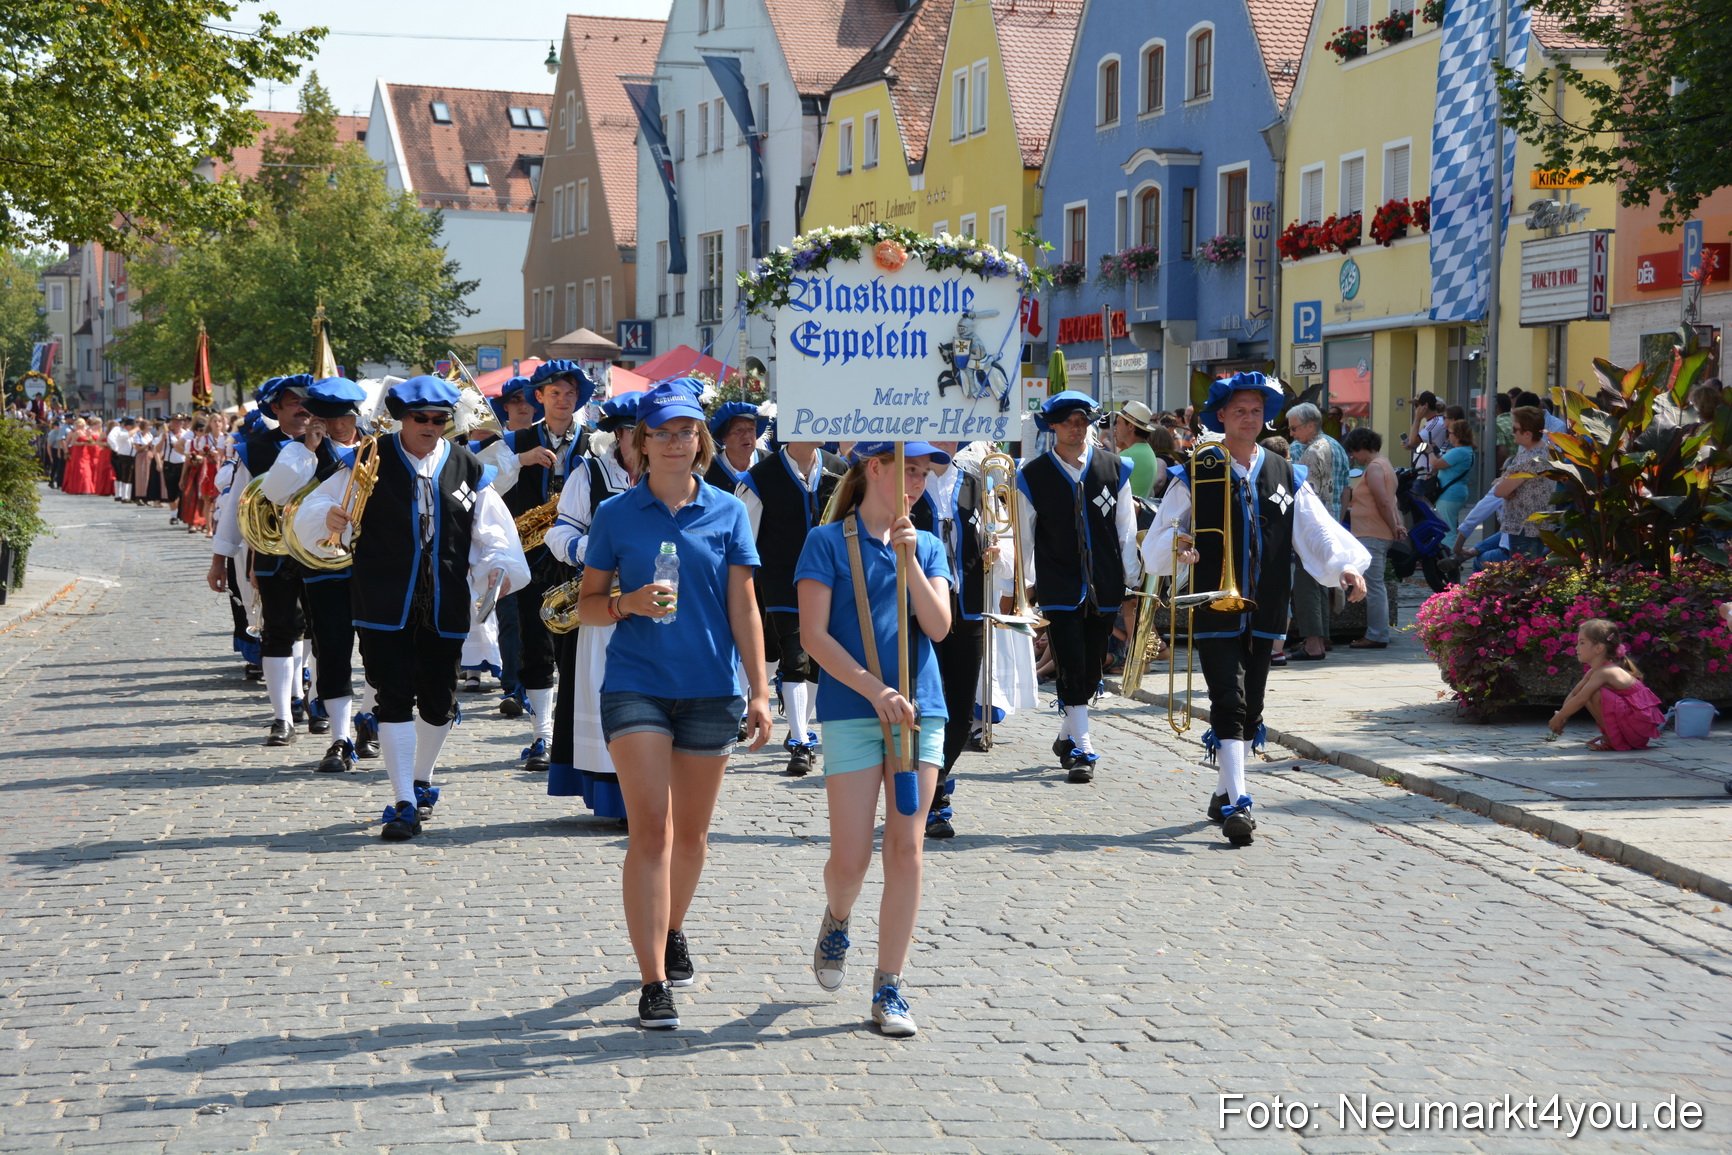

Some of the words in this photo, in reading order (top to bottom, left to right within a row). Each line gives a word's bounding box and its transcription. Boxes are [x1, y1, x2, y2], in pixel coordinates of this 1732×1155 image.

[852, 201, 879, 226] HOTEL
[886, 197, 917, 219] Lehmeier
[1252, 202, 1272, 221] CAFÉ
[1253, 225, 1269, 309] WITTL
[1532, 271, 1557, 289] RIALTO
[1559, 268, 1578, 285] KINO
[1593, 235, 1605, 313] KINO
[1638, 266, 1655, 285] DER
[789, 275, 975, 319] Blaskapelle
[621, 324, 648, 349] KL
[1300, 306, 1316, 339] P
[790, 320, 928, 366] Eppelein
[873, 388, 930, 406] Markt
[791, 409, 1009, 440] Postbauer-Heng
